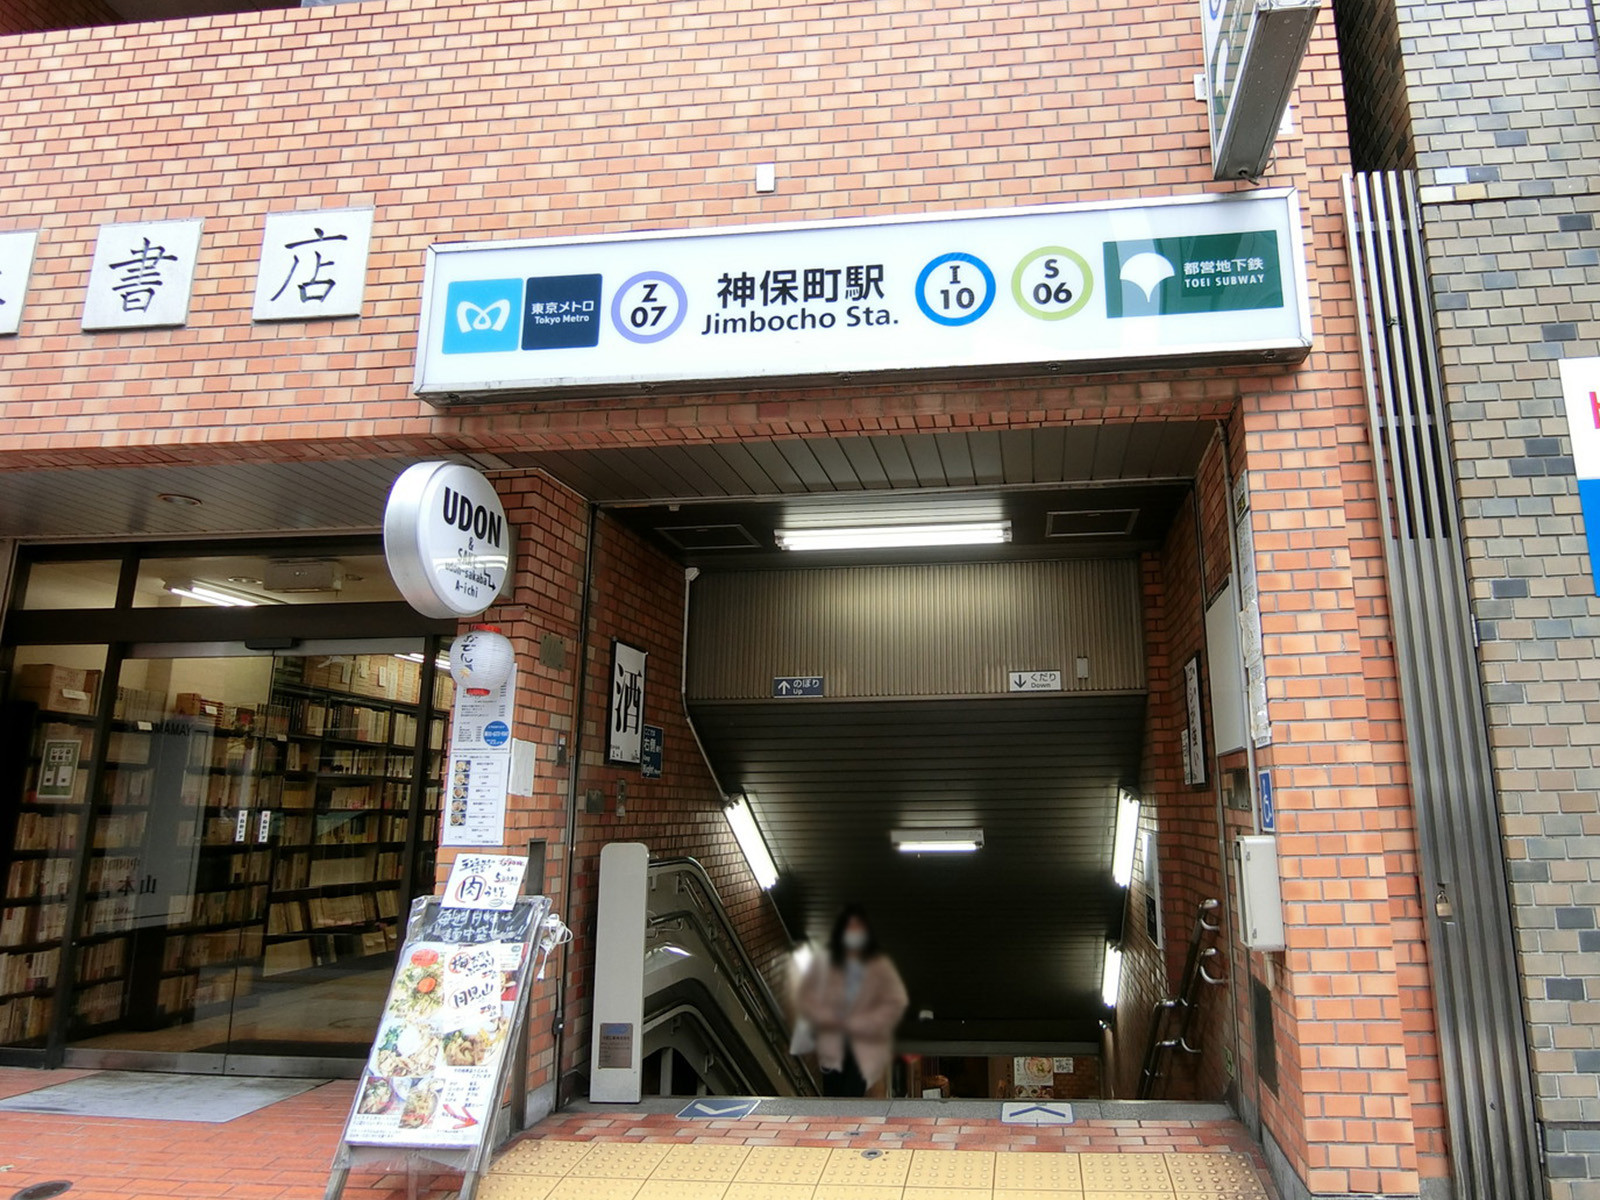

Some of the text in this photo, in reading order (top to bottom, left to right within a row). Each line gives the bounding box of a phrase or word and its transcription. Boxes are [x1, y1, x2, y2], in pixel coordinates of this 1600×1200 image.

[949, 265, 961, 284] I
[1044, 258, 1060, 279] S
[1183, 257, 1264, 275] 都営地下鉄
[717, 264, 885, 309] 神保町駅
[1184, 274, 1265, 288] TOEI SUBWAY
[641, 283, 659, 302] Z
[940, 287, 975, 310] 10
[1033, 282, 1072, 305] 06
[531, 300, 595, 315] 東京メトロ
[631, 306, 667, 328] 07
[534, 314, 590, 325] Tokyo Metro
[701, 305, 899, 335] Jimbocho Sta.
[443, 486, 502, 548] UDON
[455, 580, 479, 598] A-ichi
[793, 678, 820, 688] のぼり
[1031, 673, 1057, 682] くだり
[615, 662, 643, 735] 酒
[793, 688, 803, 696] Up
